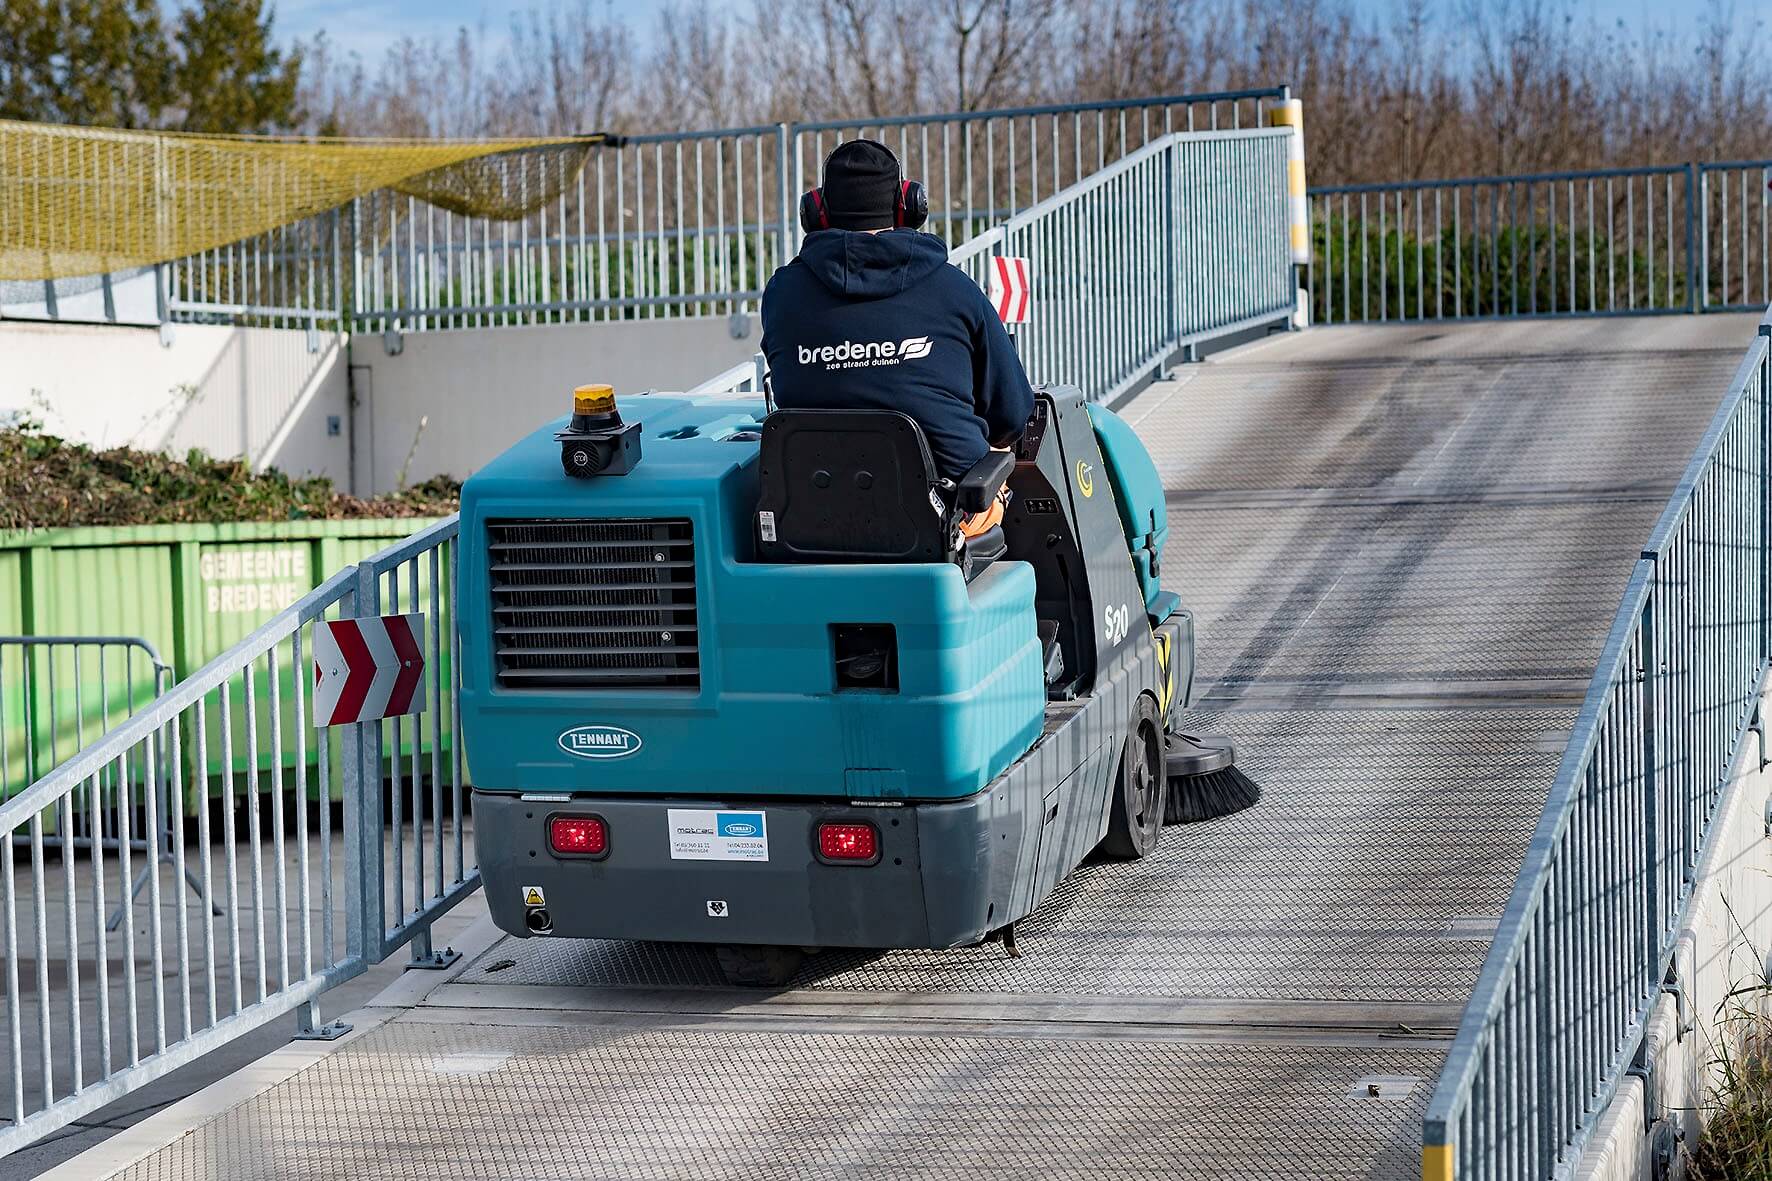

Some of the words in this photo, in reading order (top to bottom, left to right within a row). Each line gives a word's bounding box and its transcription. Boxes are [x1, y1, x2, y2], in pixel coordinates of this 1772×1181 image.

[798, 340, 896, 364] bredene
[843, 360, 869, 368] strand
[871, 358, 900, 367] duinen
[200, 549, 305, 581] GEMEENTE
[207, 582, 298, 613] BREDENE
[1104, 603, 1129, 648] S20
[569, 733, 630, 749] TENNANT
